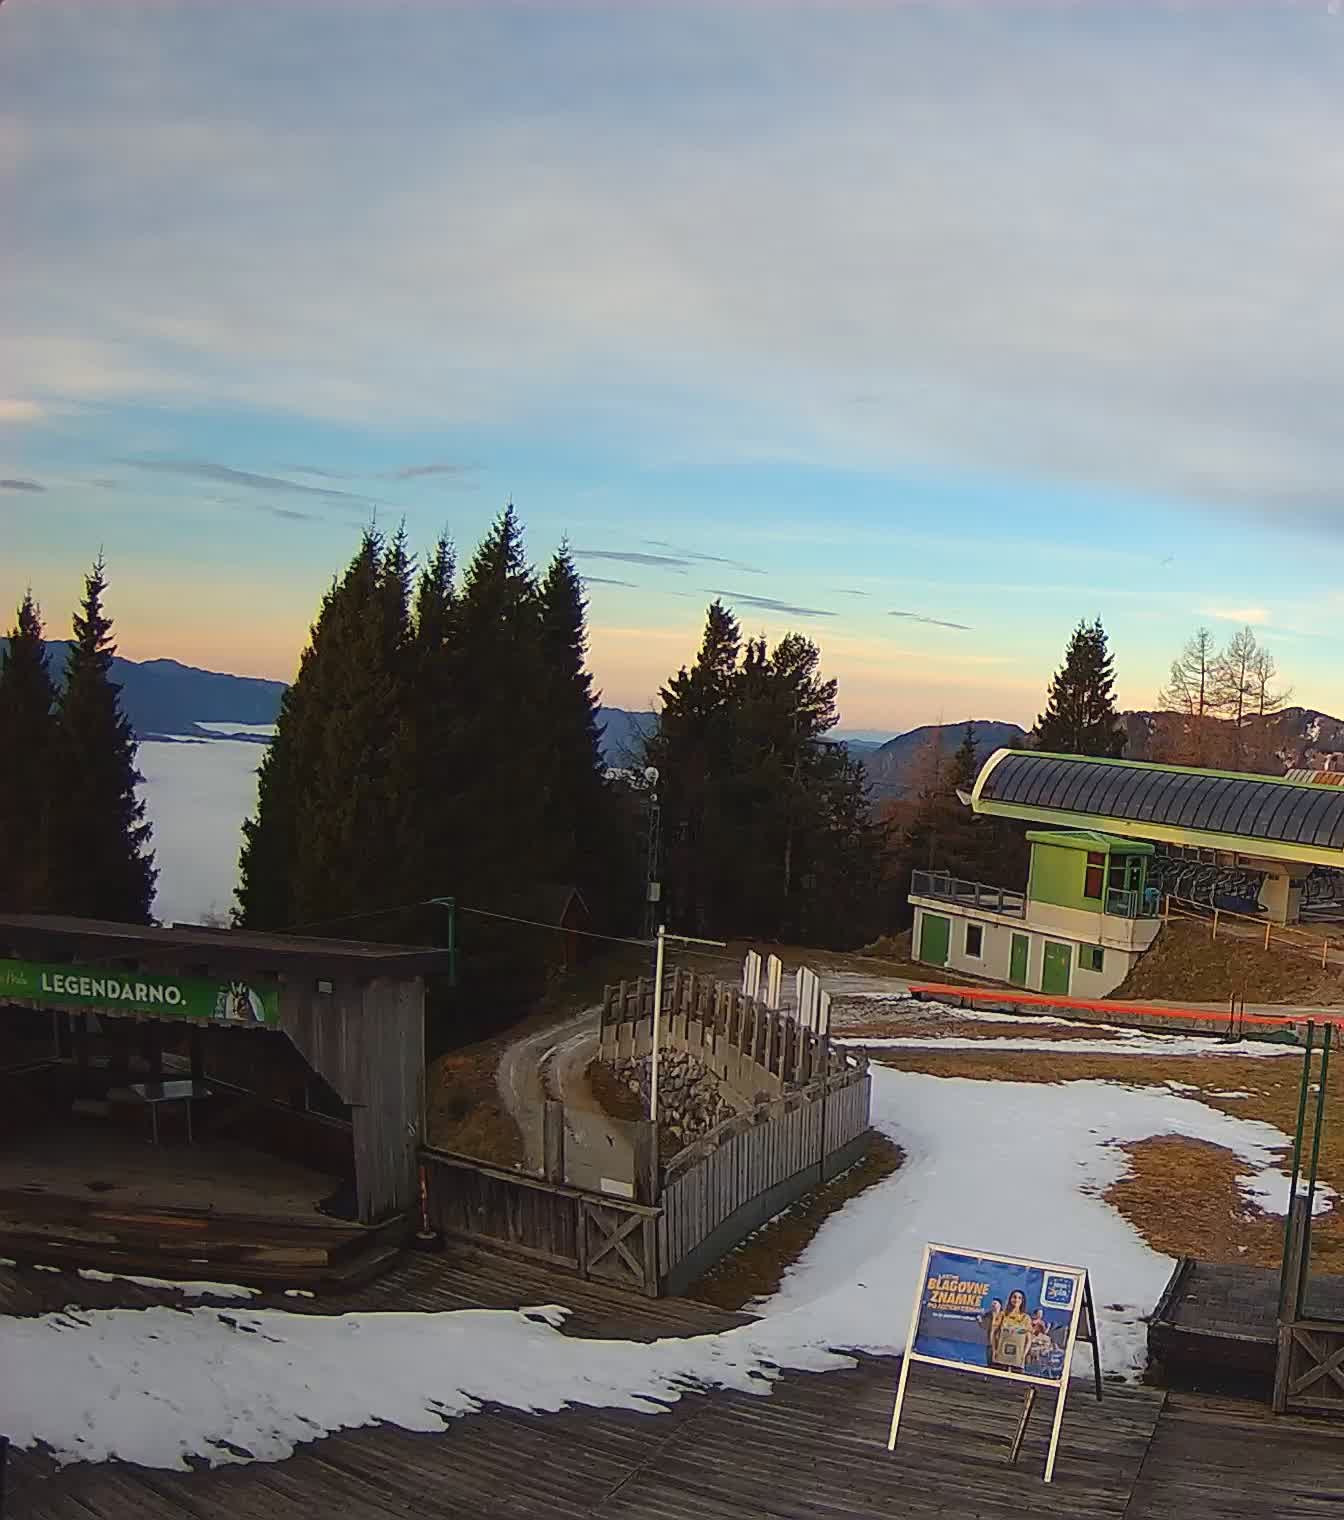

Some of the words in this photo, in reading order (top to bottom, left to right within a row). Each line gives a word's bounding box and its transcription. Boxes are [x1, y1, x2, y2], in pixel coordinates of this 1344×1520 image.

[41, 972, 187, 1005] LEGENDARNO.
[927, 1277, 991, 1296] BLAGOVNE
[929, 1290, 983, 1307] ZNAMKE
